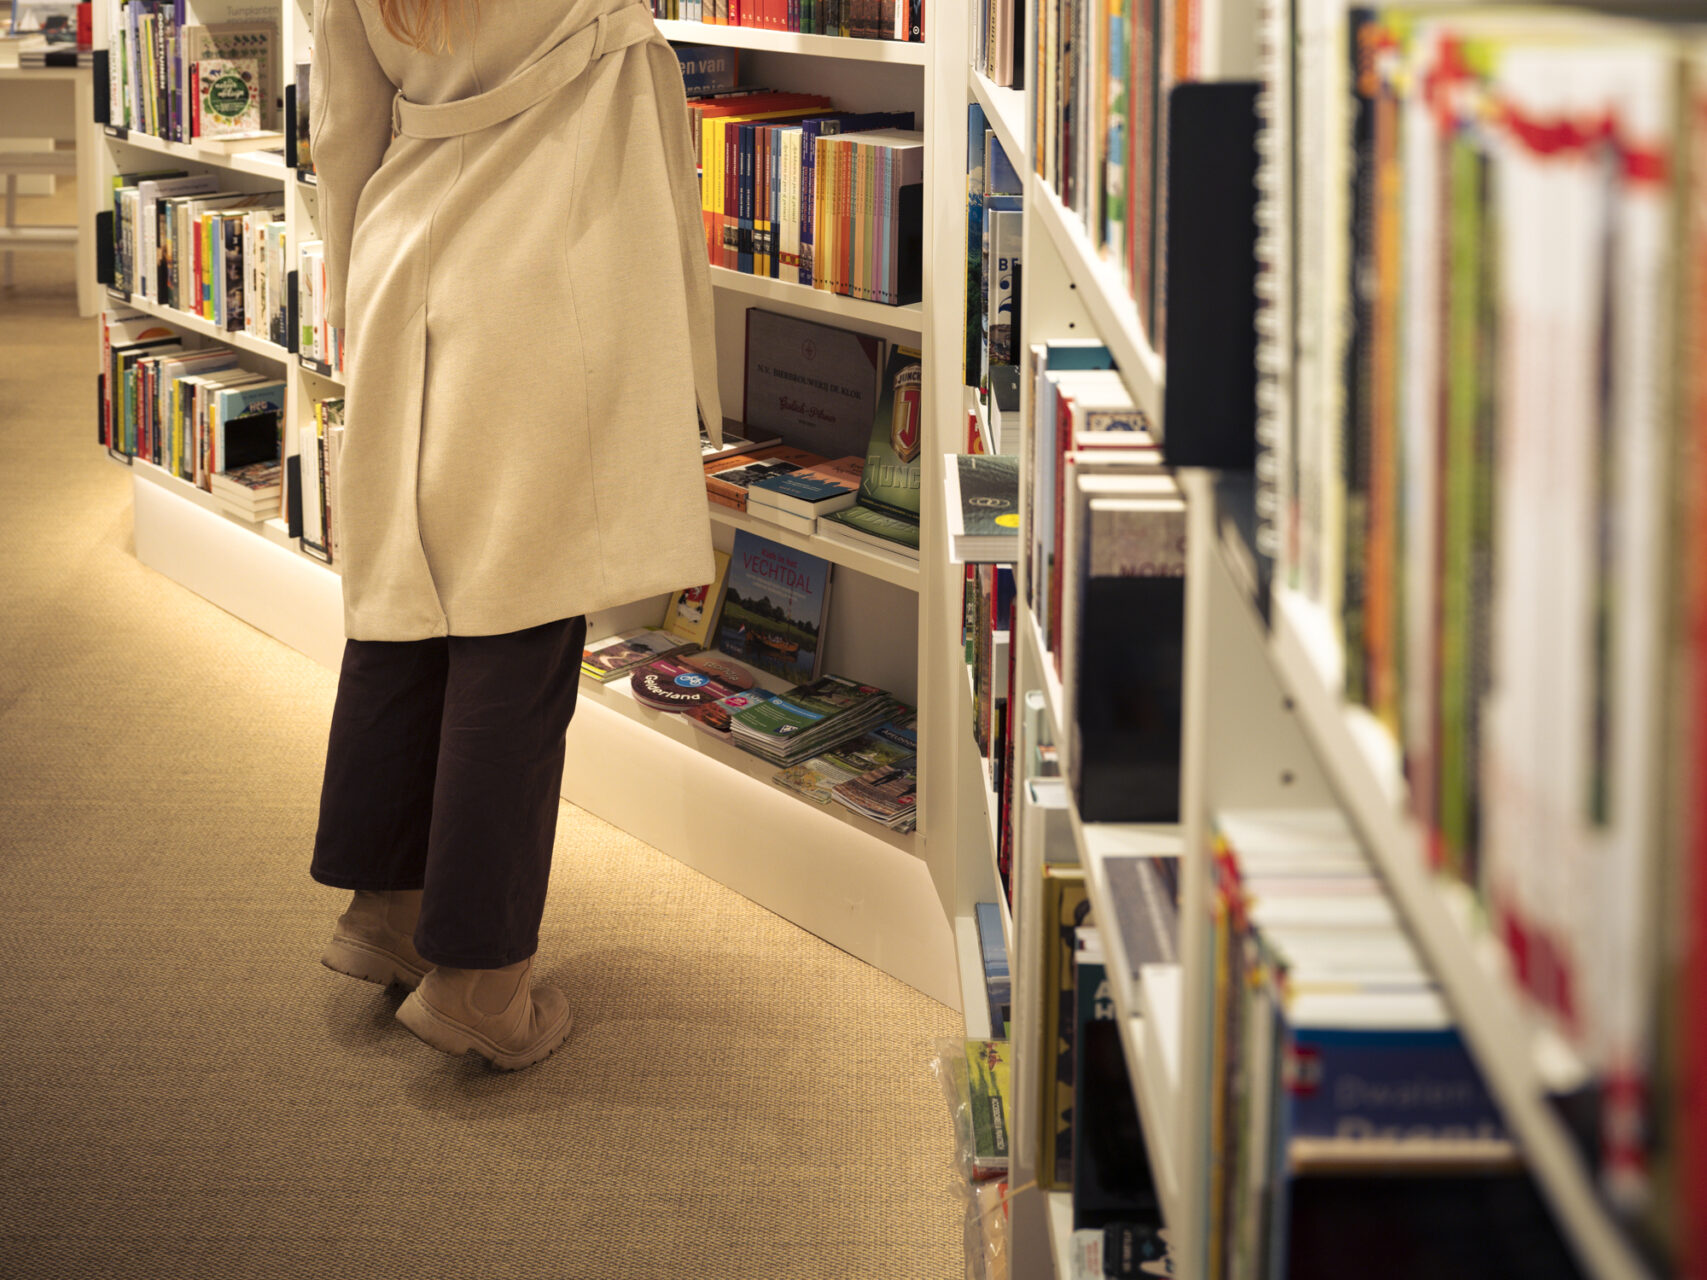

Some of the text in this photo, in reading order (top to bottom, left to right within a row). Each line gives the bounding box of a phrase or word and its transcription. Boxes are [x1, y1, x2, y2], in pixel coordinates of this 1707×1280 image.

[157, 13, 166, 90] OOGSTTUINEN
[699, 59, 726, 74] van
[773, 368, 829, 393] BIERBROUWERIJ
[829, 385, 840, 394] DE
[841, 387, 862, 400] KLOK
[743, 551, 813, 595] VECHTDAL
[644, 673, 701, 701] Gelderland
